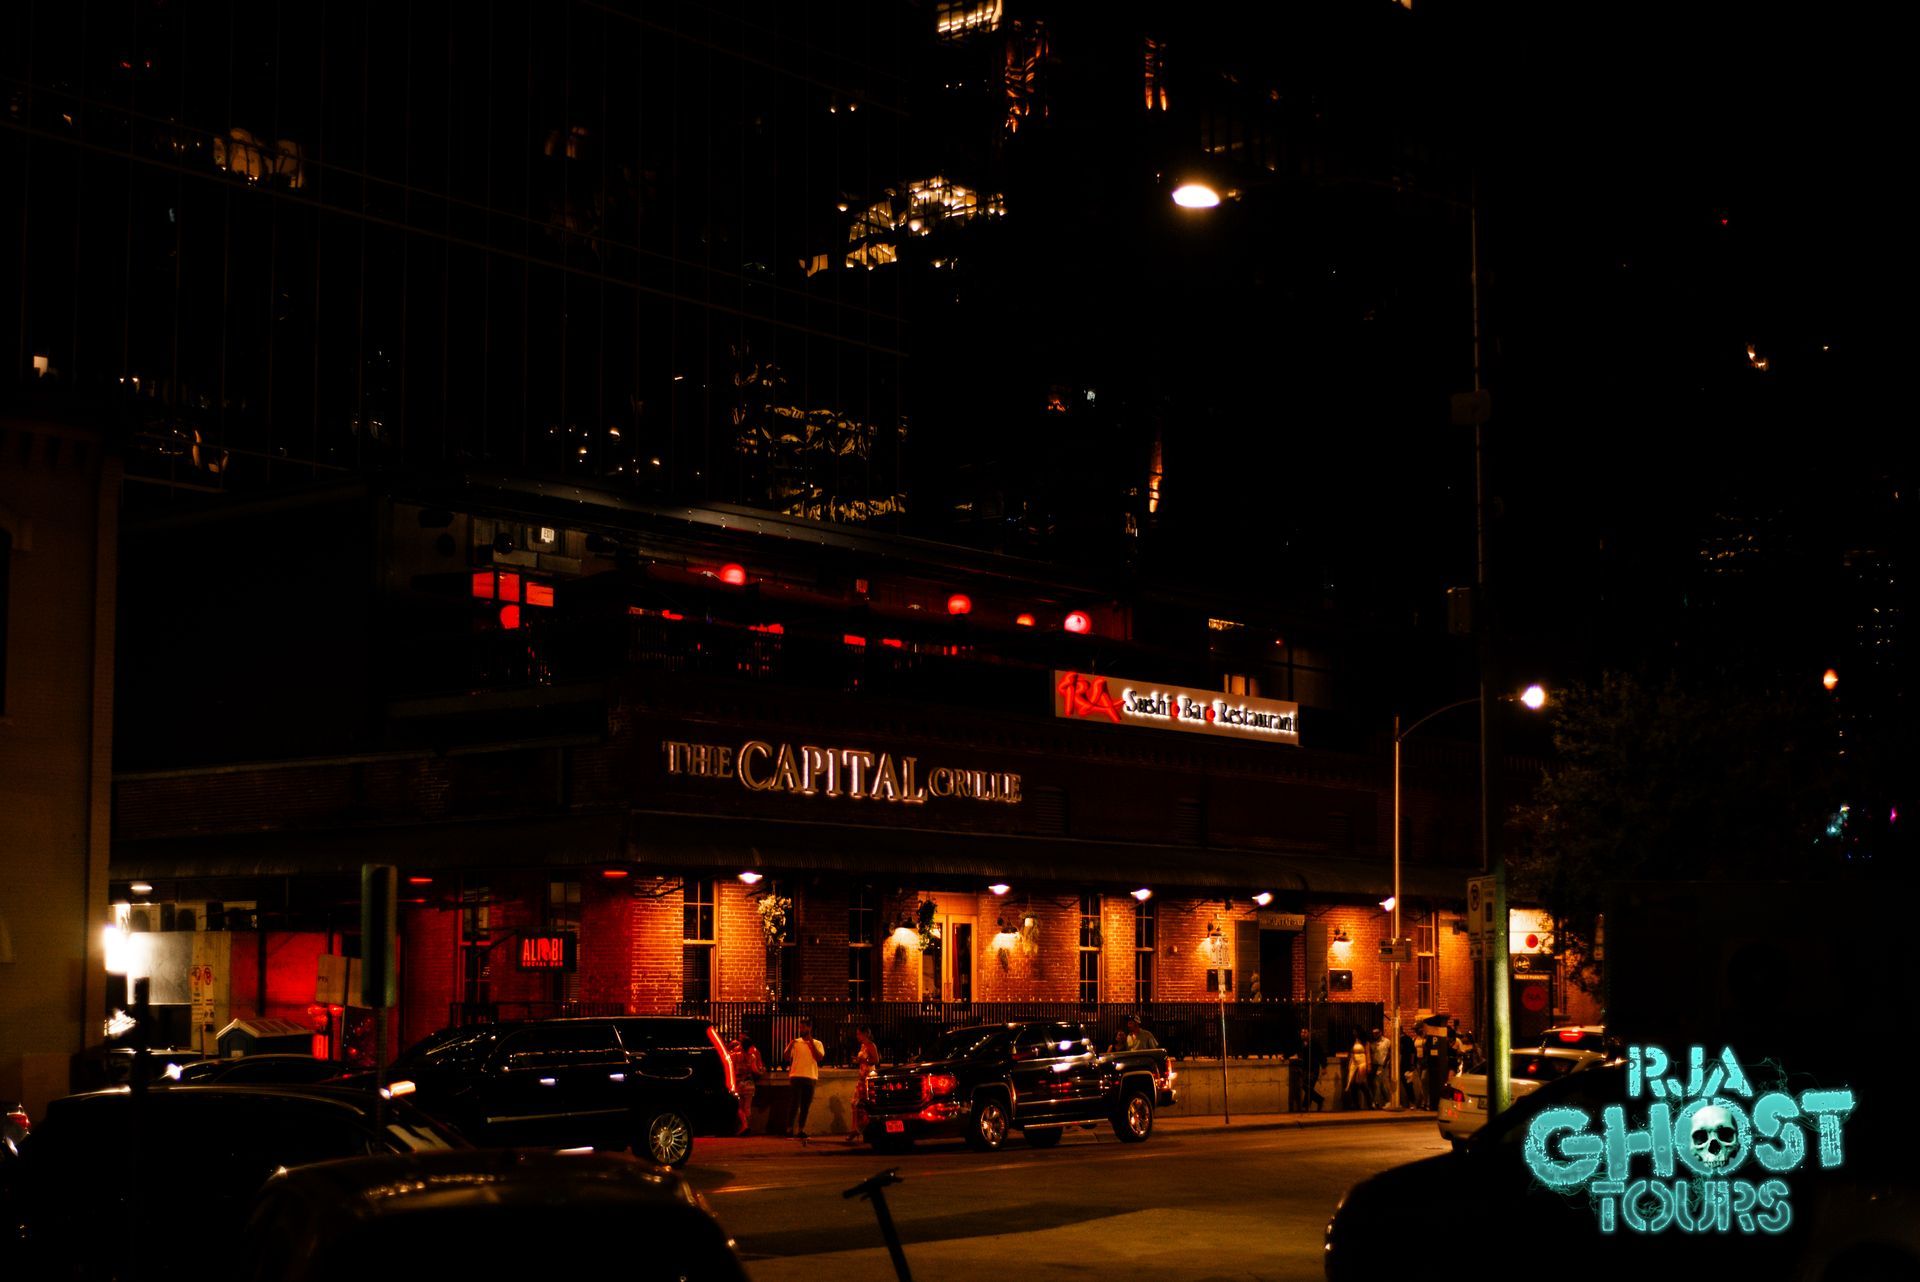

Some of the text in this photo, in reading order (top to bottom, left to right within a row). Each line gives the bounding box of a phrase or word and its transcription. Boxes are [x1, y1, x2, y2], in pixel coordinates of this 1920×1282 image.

[1125, 689, 1173, 717] Sushi
[1182, 697, 1206, 721] Bar
[1220, 701, 1299, 732] Restaurant
[662, 740, 1023, 804] THE CAPITAL GRILLE
